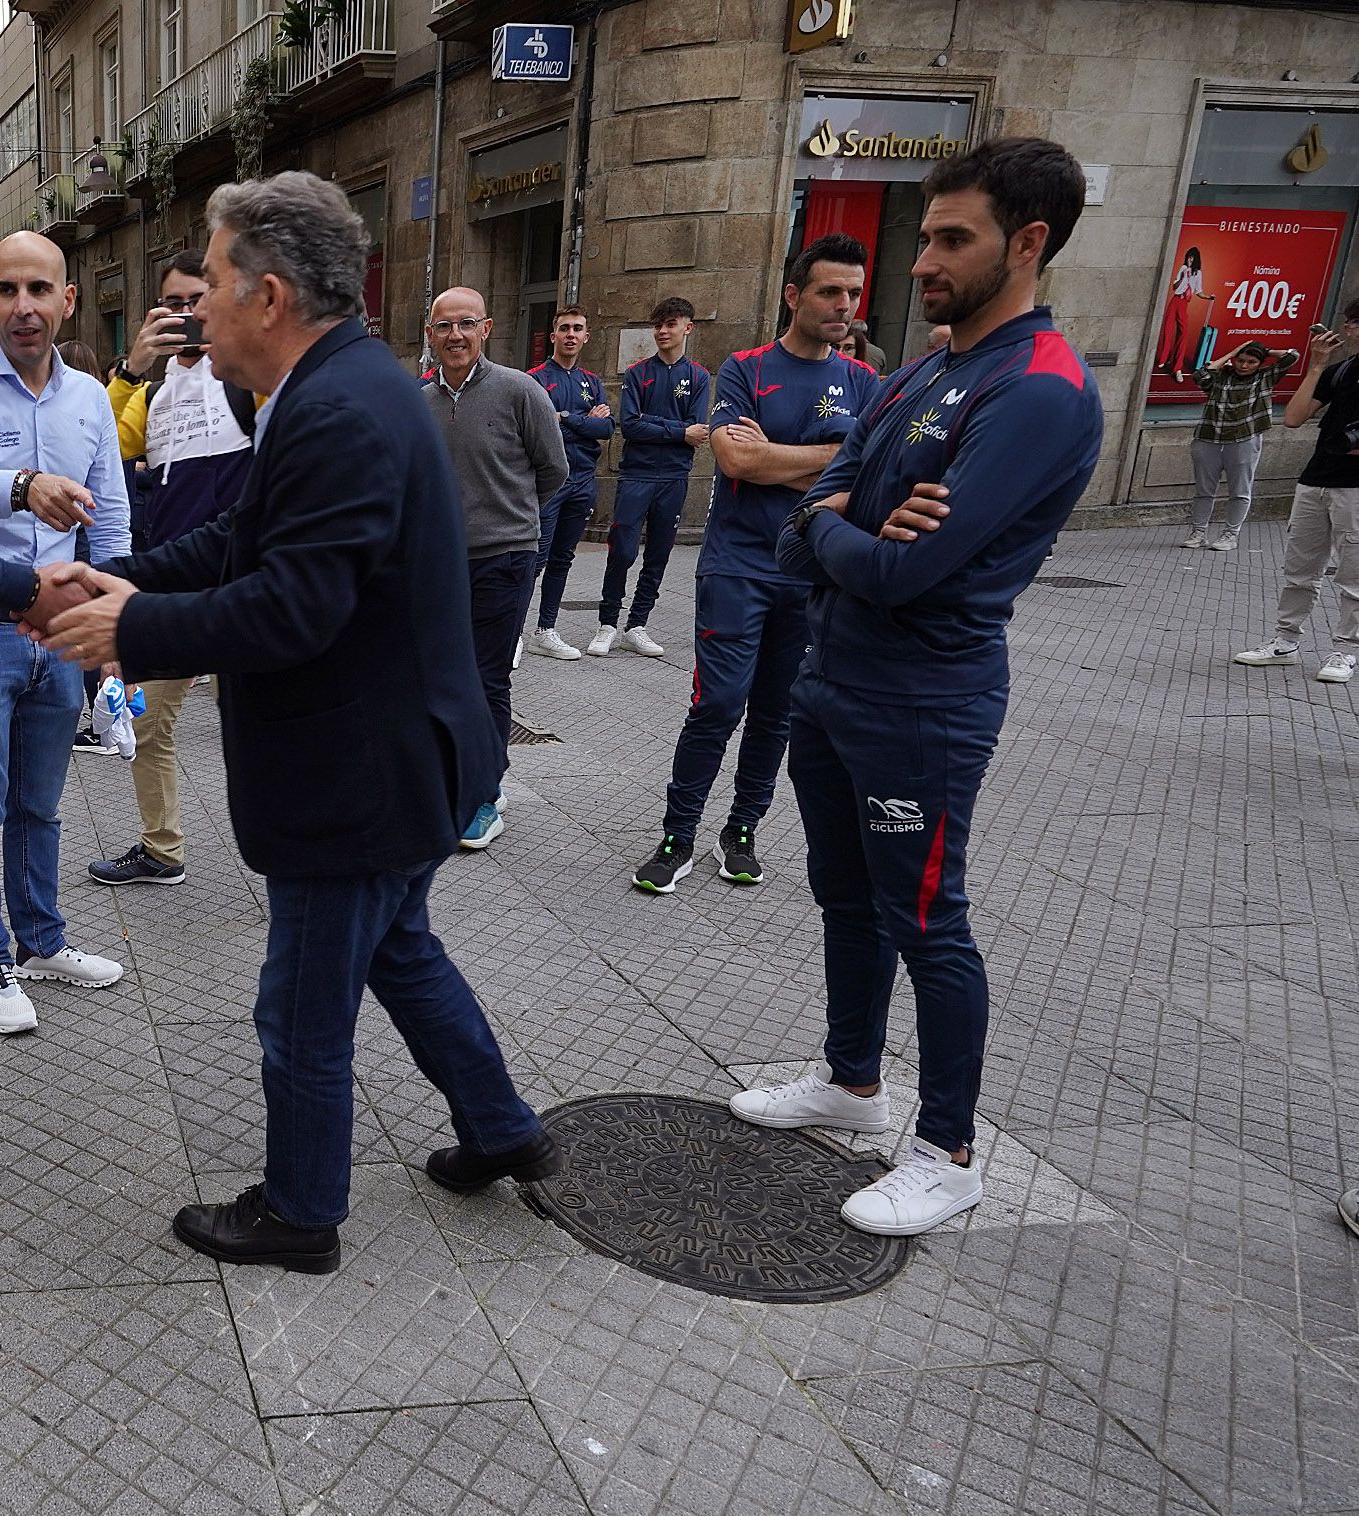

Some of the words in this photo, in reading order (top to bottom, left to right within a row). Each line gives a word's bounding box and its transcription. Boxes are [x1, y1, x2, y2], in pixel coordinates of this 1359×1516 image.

[508, 60, 564, 75] TELEBANCO
[843, 129, 967, 159] Santander
[1219, 221, 1300, 234] BIENESTANDO
[1253, 265, 1281, 276] Nómina
[919, 422, 948, 441] Cofidi
[870, 823, 924, 832] CICLISMO
